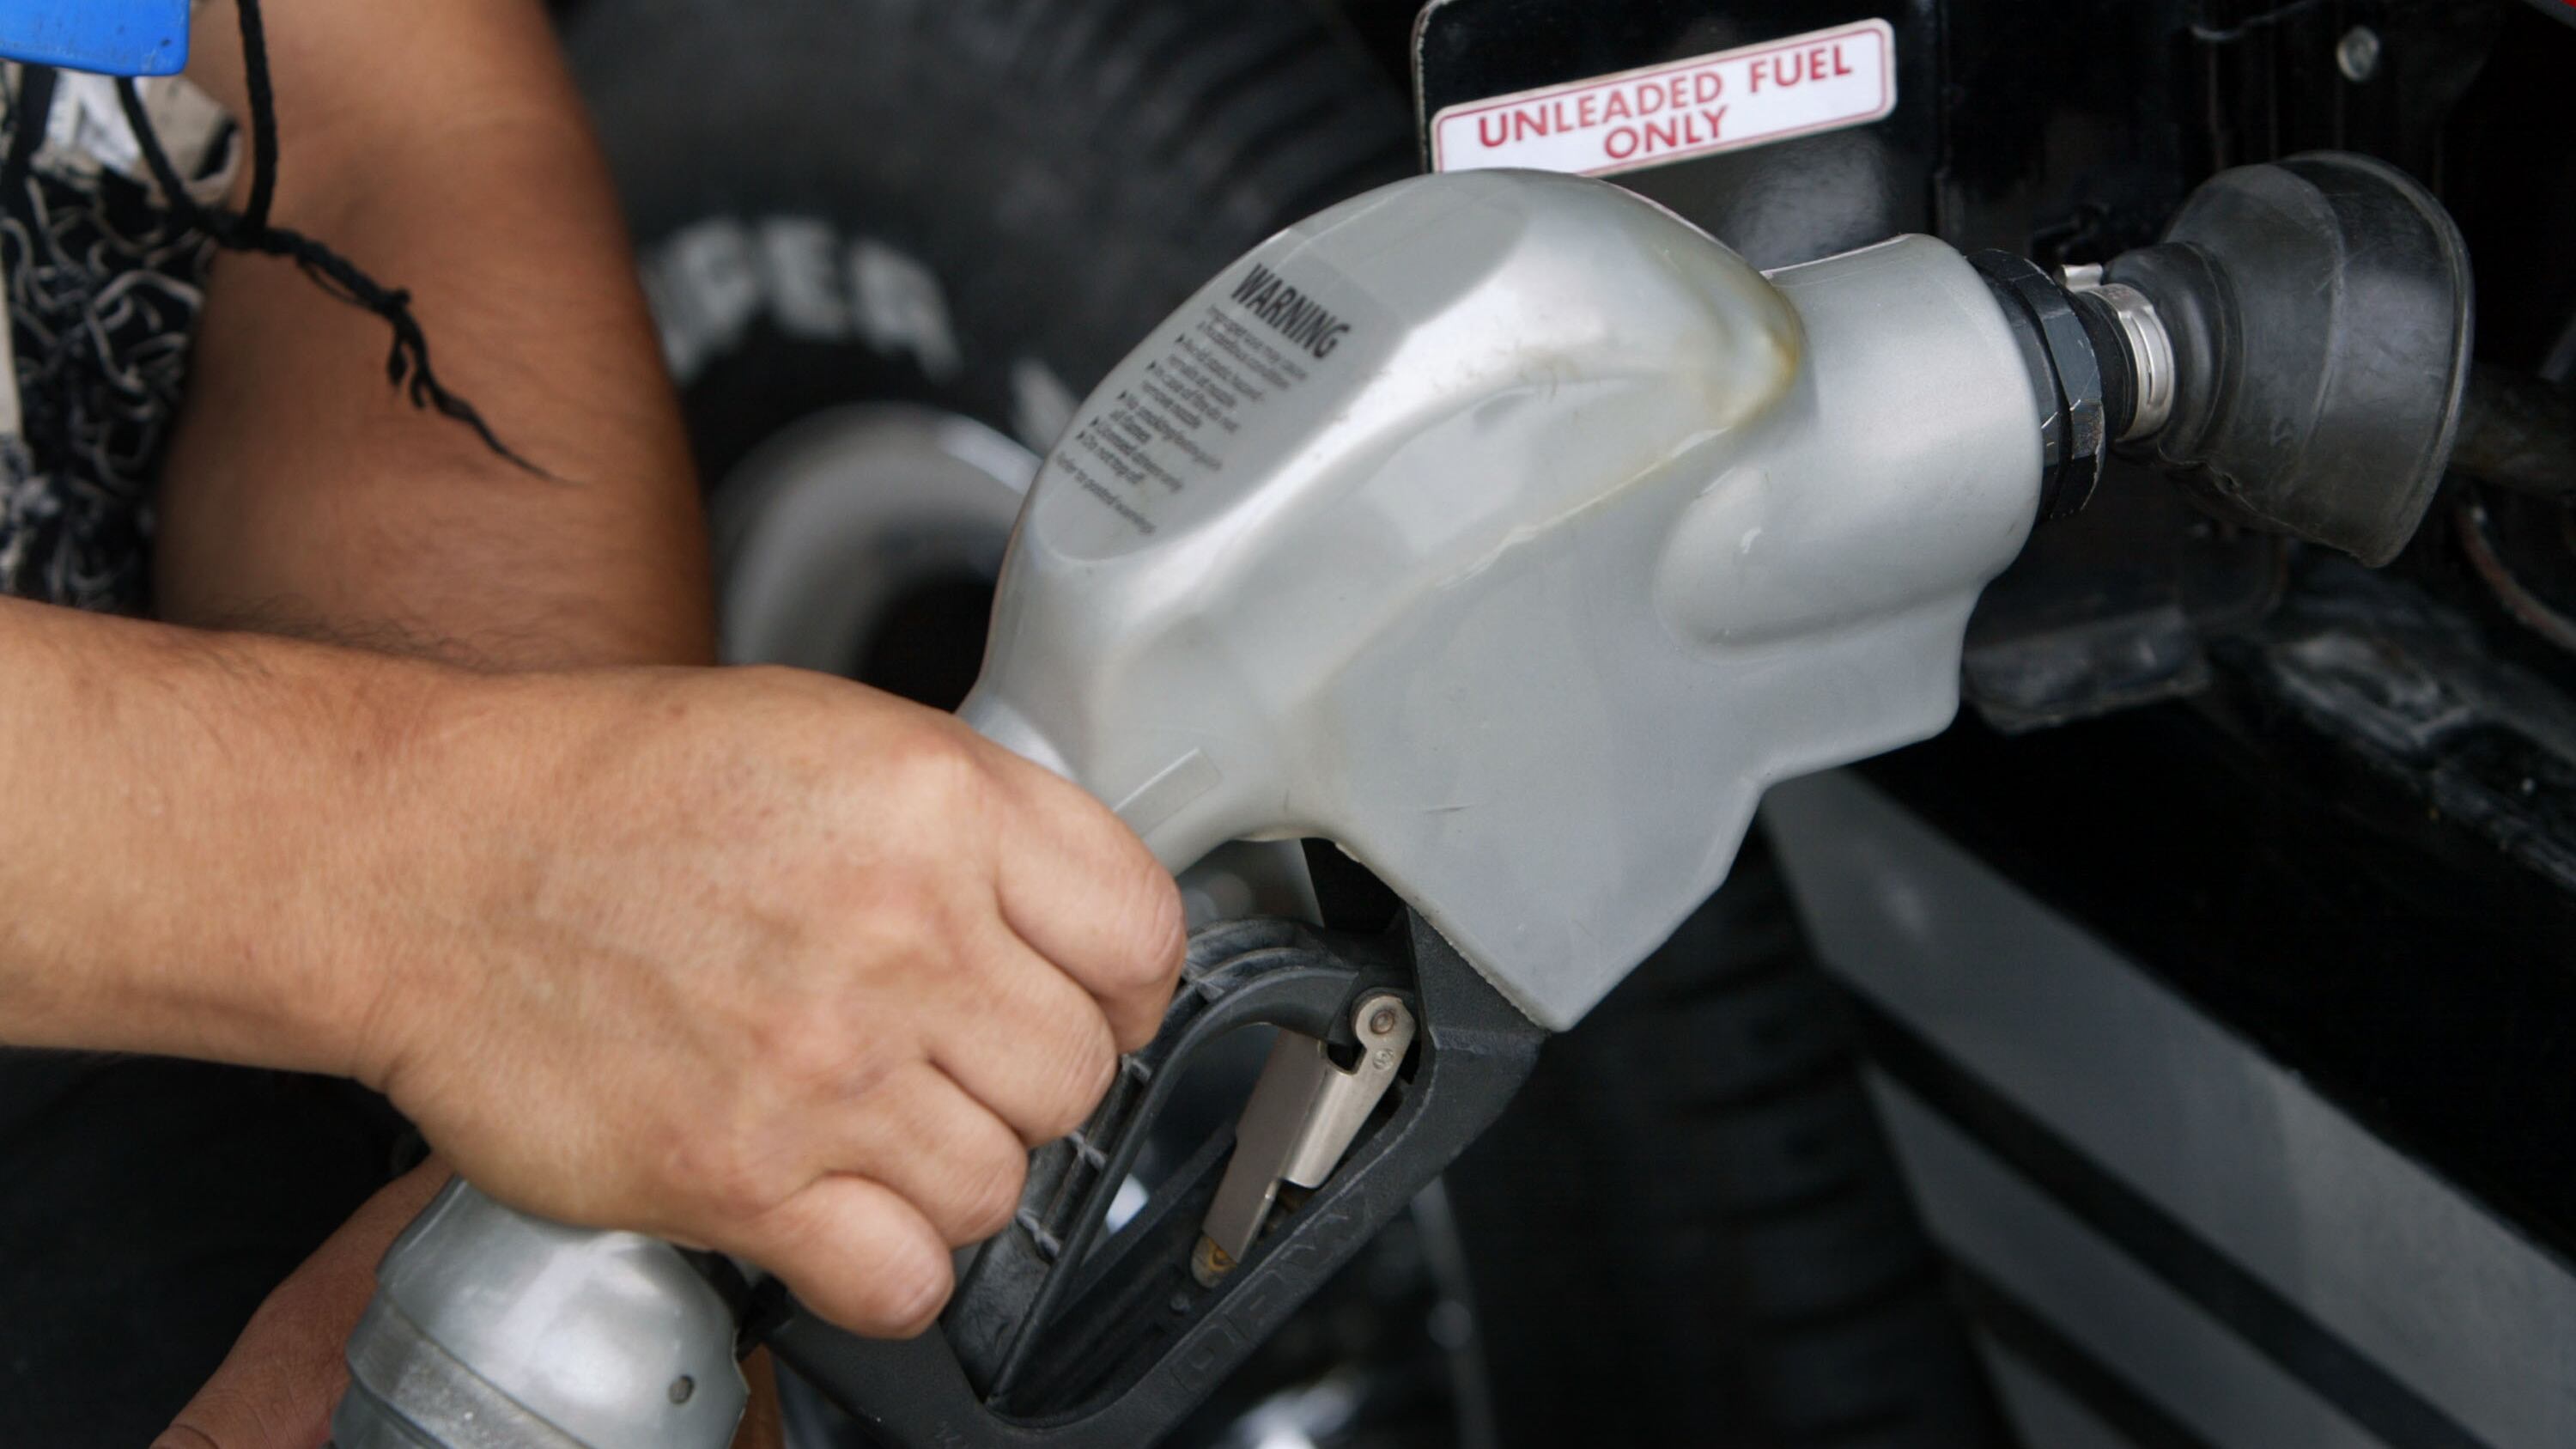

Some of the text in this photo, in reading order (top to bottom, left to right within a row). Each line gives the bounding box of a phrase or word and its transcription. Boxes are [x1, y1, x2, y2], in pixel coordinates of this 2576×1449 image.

[1478, 43, 1854, 149] UNLEADED FUEL
[1603, 104, 1728, 160] ONLY
[1230, 263, 1351, 359] WARNING
